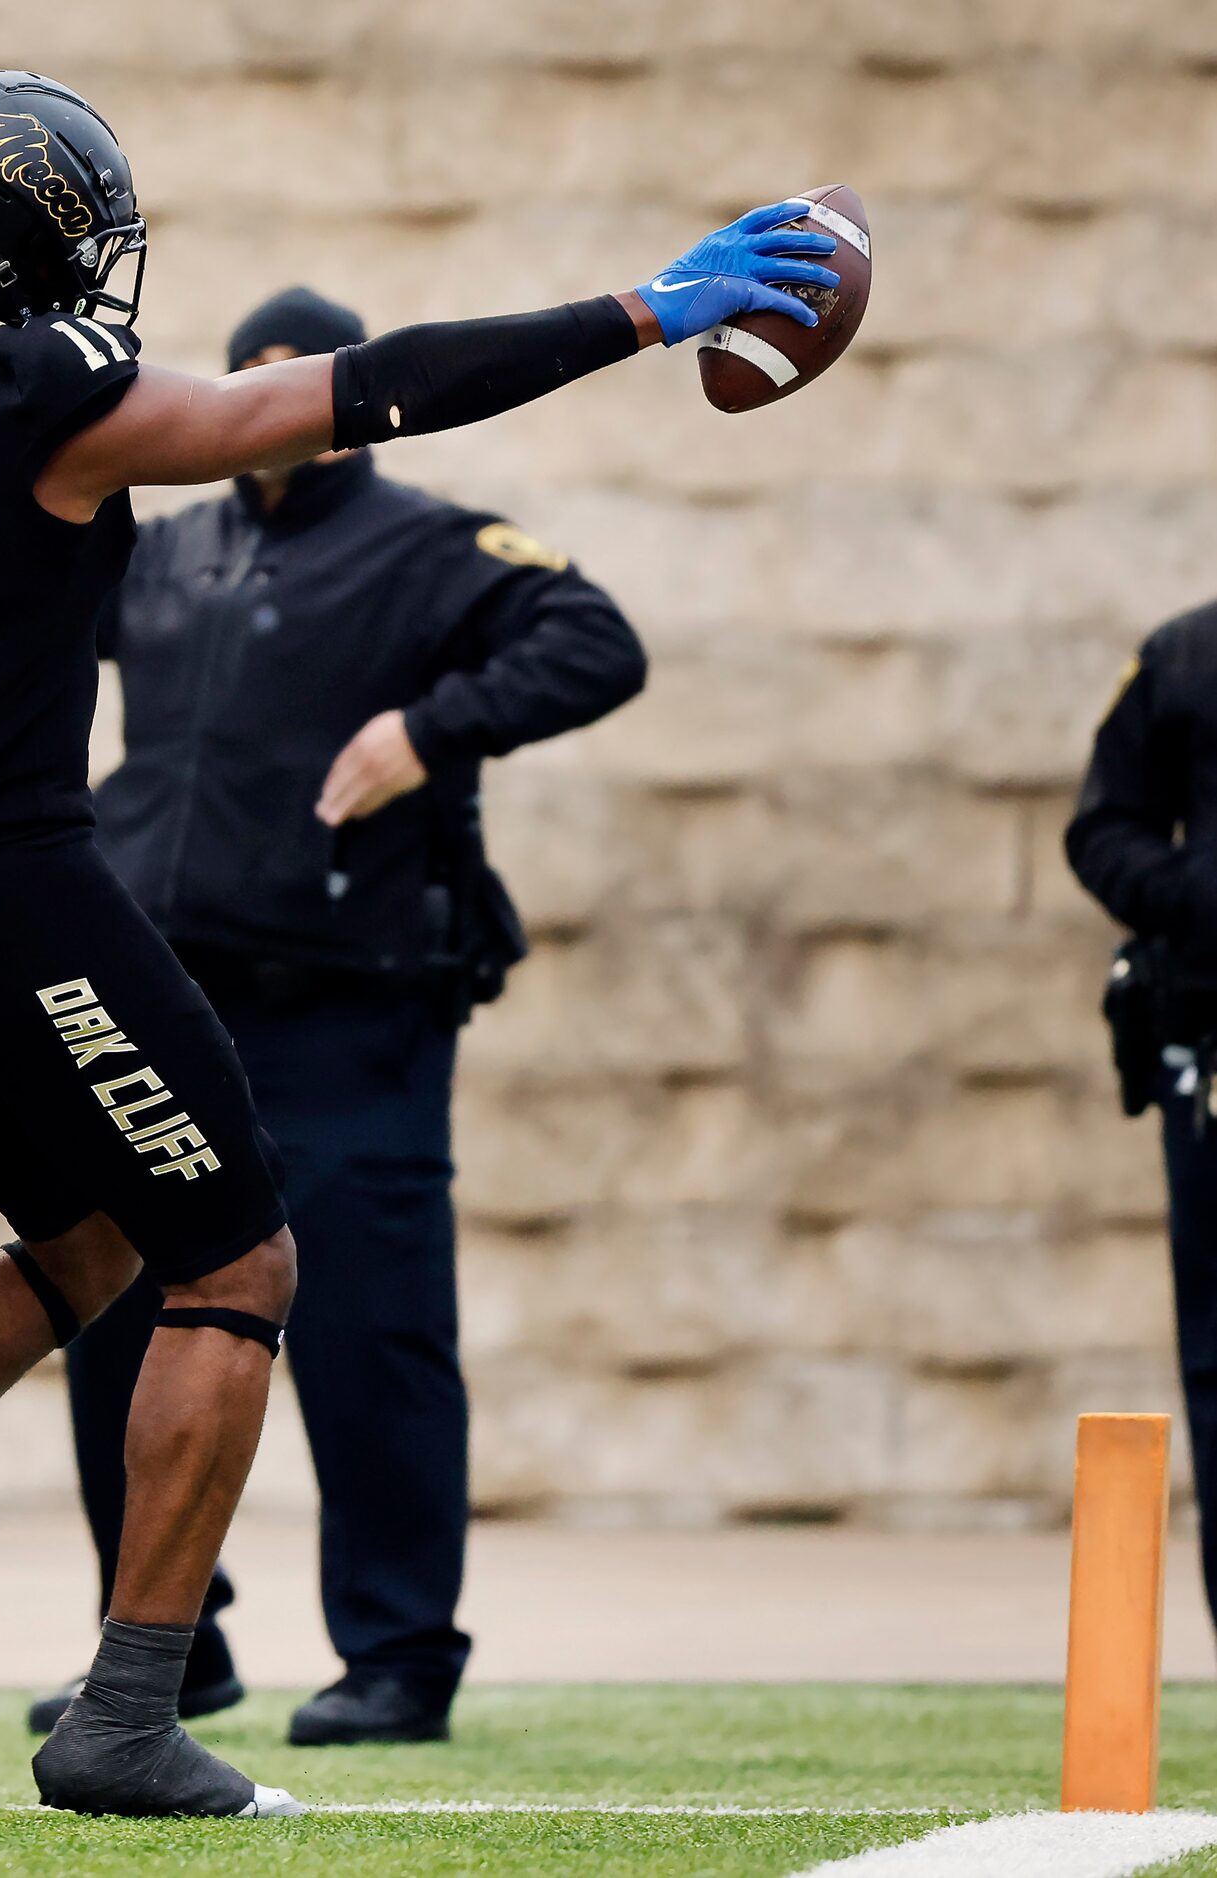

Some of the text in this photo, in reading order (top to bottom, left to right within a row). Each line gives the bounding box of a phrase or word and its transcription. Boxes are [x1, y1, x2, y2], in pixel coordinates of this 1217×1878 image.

[51, 316, 130, 371] 11
[36, 977, 222, 1181] OAK CLIFF
